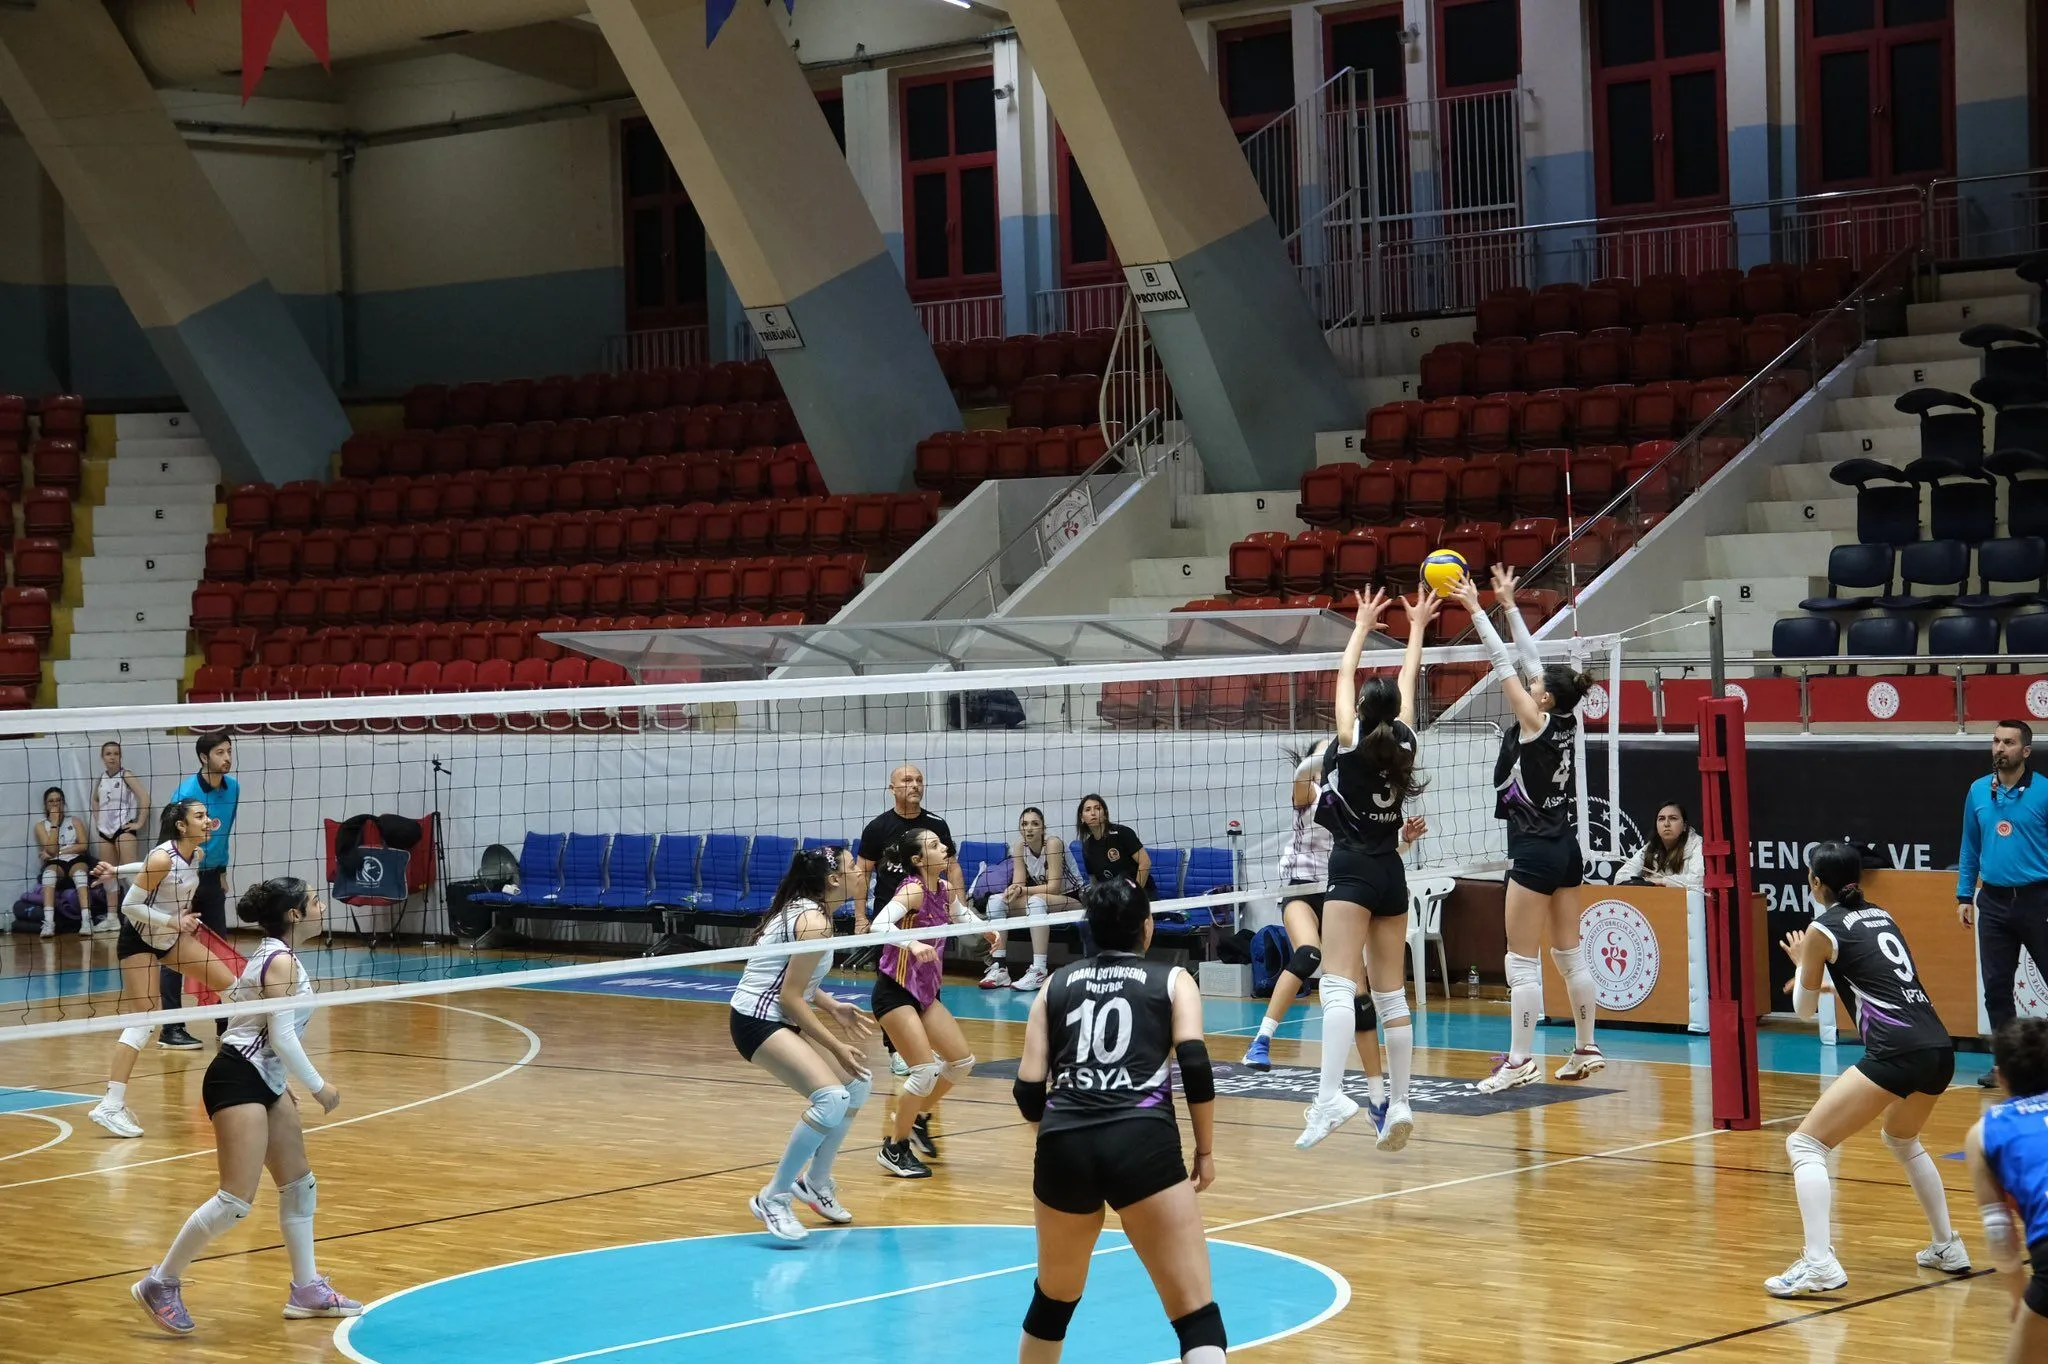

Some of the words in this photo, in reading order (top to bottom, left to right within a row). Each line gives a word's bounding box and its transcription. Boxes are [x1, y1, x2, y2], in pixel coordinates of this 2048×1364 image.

[1145, 272, 1155, 282] B
[1135, 289, 1182, 303] PROTOKOL
[1961, 307, 1970, 318] F
[1410, 327, 1420, 338] G
[1913, 370, 1924, 382] E
[1402, 381, 1409, 392] F
[168, 418, 179, 426] G
[1344, 437, 1353, 448] E
[1861, 439, 1872, 451] D
[161, 463, 168, 472] F
[1256, 499, 1265, 509] D
[155, 510, 163, 519] E
[1803, 506, 1815, 519] C
[145, 560, 155, 569] D
[1182, 564, 1191, 576] C
[1740, 586, 1750, 598] B
[135, 612, 144, 621] C
[119, 663, 129, 672] B
[1551, 749, 1571, 791] 4
[1887, 843, 1931, 870] VE
[1877, 932, 1914, 982] 9
[1066, 967, 1096, 987] ADANA
[1066, 996, 1133, 1064] 10
[1054, 1067, 1134, 1091] ASYA
